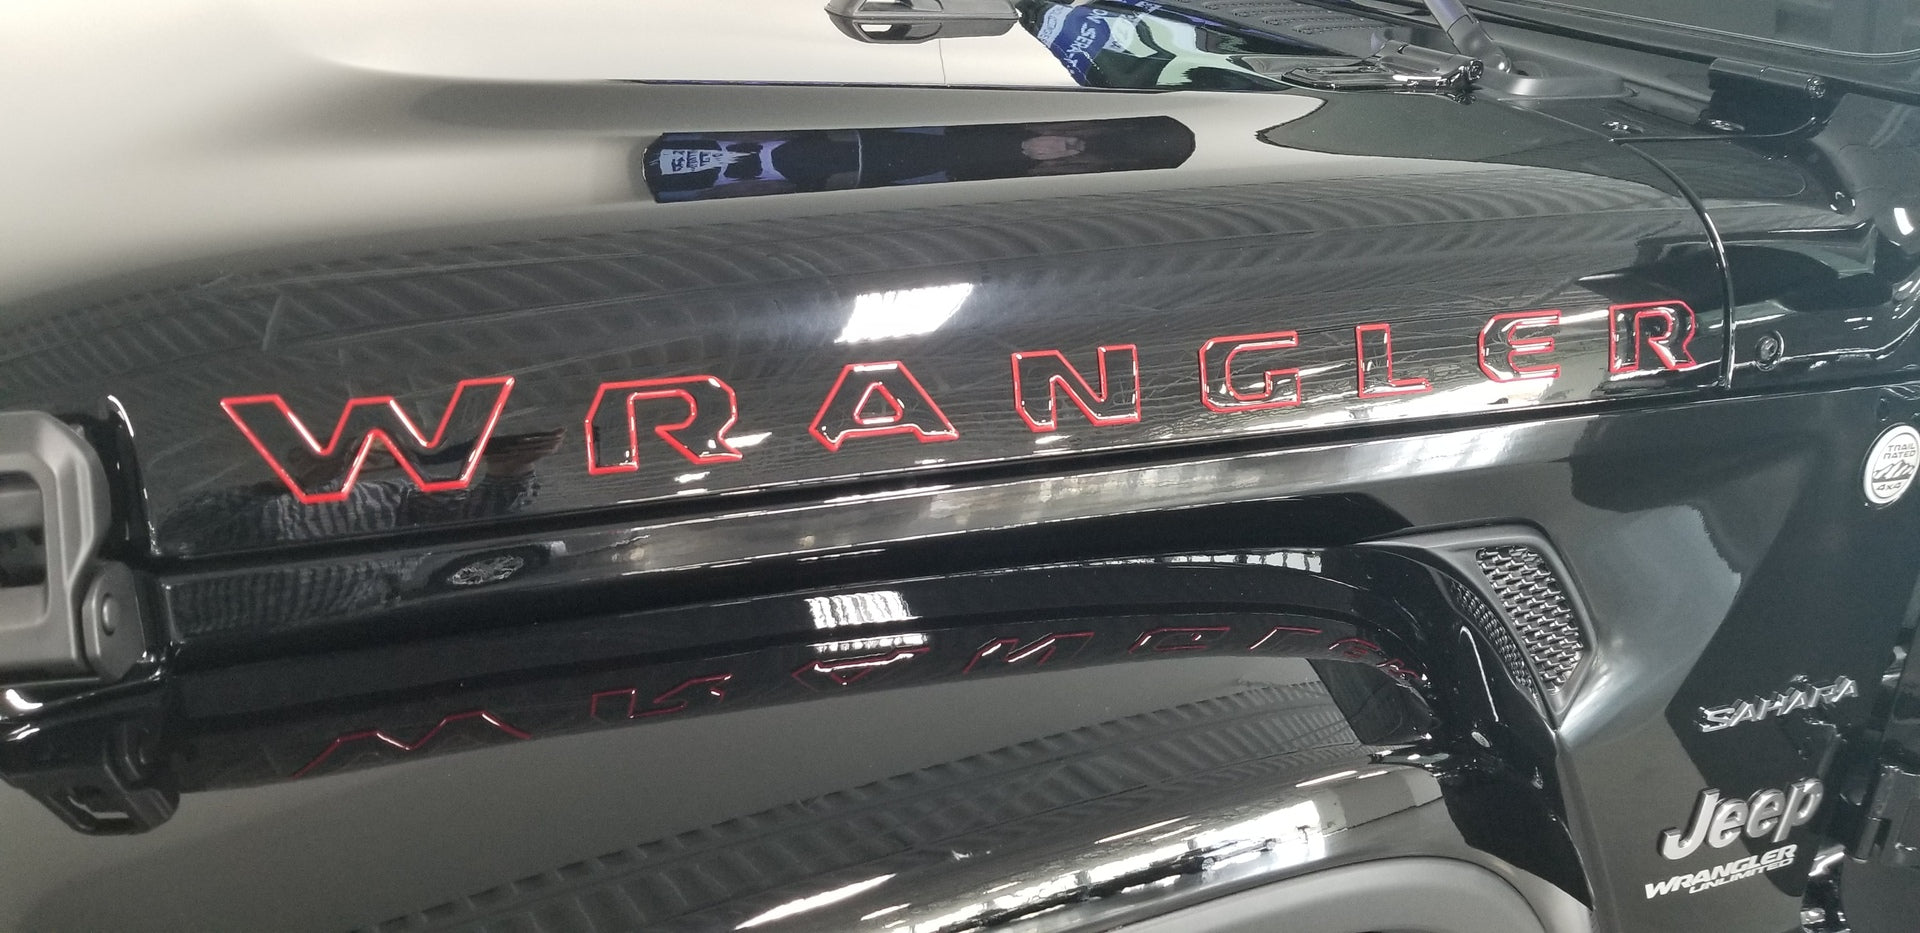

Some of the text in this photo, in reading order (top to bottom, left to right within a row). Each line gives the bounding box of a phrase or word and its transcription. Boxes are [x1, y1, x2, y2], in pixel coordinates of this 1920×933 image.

[220, 299, 1697, 504] WRANGLER
[1883, 450, 1917, 460] RATED
[1887, 443, 1916, 453] TRAIL
[1698, 675, 1859, 733] SAHARA
[1657, 777, 1824, 861] Jeep
[1644, 844, 1798, 900] WRANGLER
[1688, 857, 1794, 894] UNLIMITED
